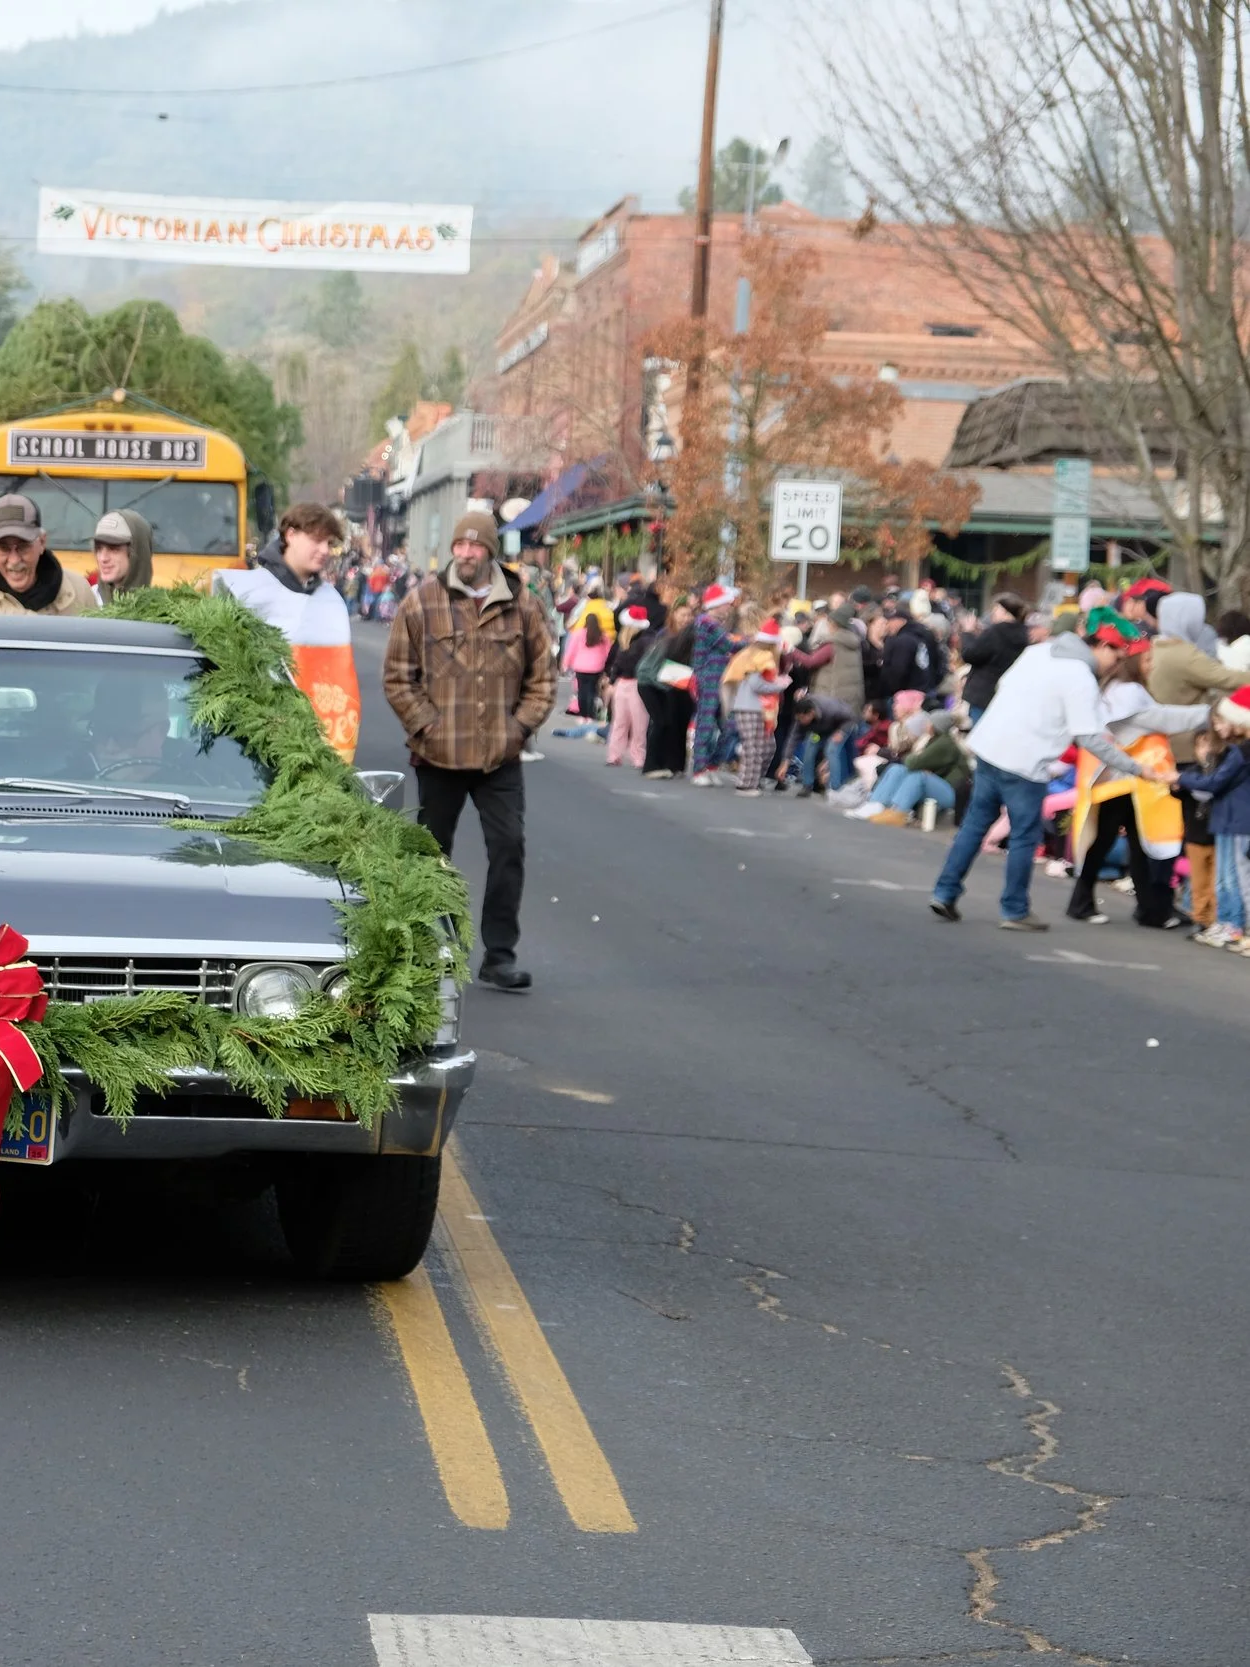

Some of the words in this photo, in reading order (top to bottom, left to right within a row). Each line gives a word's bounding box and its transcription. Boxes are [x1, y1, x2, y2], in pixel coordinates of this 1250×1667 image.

[83, 206, 248, 244] VICTORIAN
[257, 217, 436, 252] CHRISTMAS
[17, 437, 85, 458] SCHOOL
[95, 439, 152, 459] HOUSE
[161, 440, 197, 461] BUS
[782, 489, 835, 504] SPEED
[787, 507, 828, 519] LIMIT
[781, 524, 830, 551] 20
